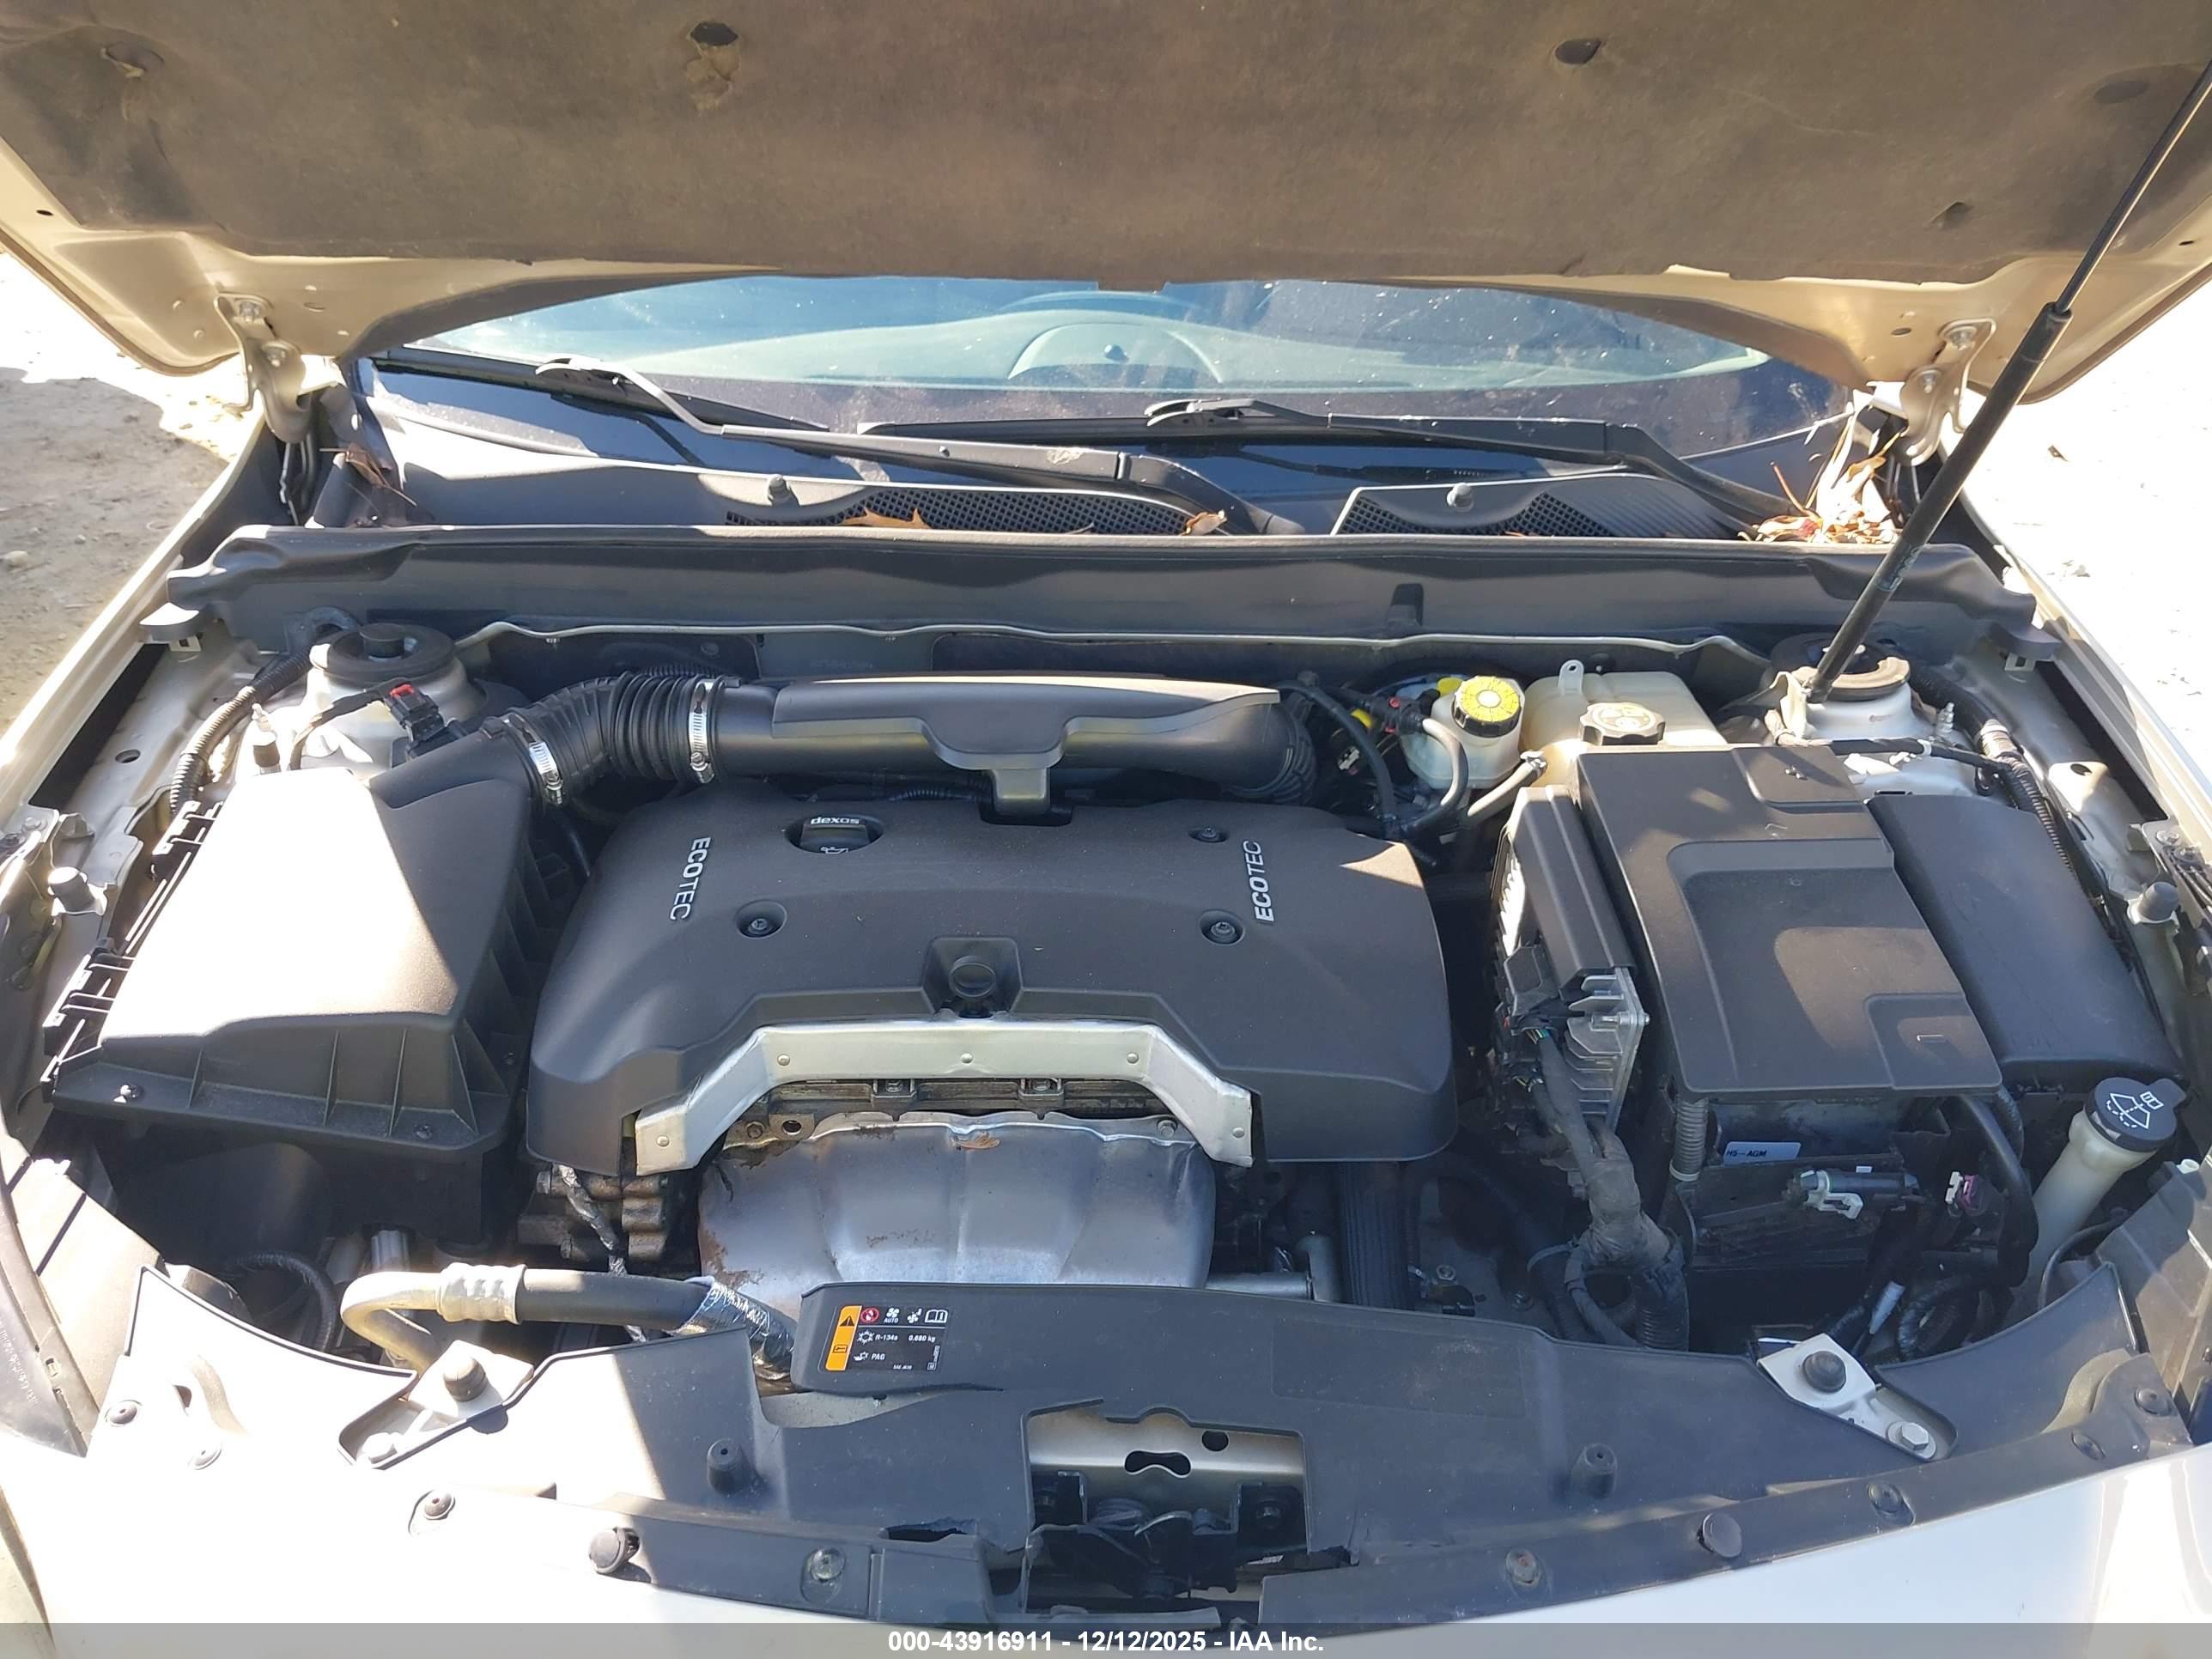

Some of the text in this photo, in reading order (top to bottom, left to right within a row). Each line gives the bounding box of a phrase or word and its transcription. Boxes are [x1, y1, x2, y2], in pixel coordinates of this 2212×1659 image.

[810, 817, 860, 825] dexos
[670, 836, 712, 921] ECOTEC
[1243, 841, 1275, 922] ECOTEC
